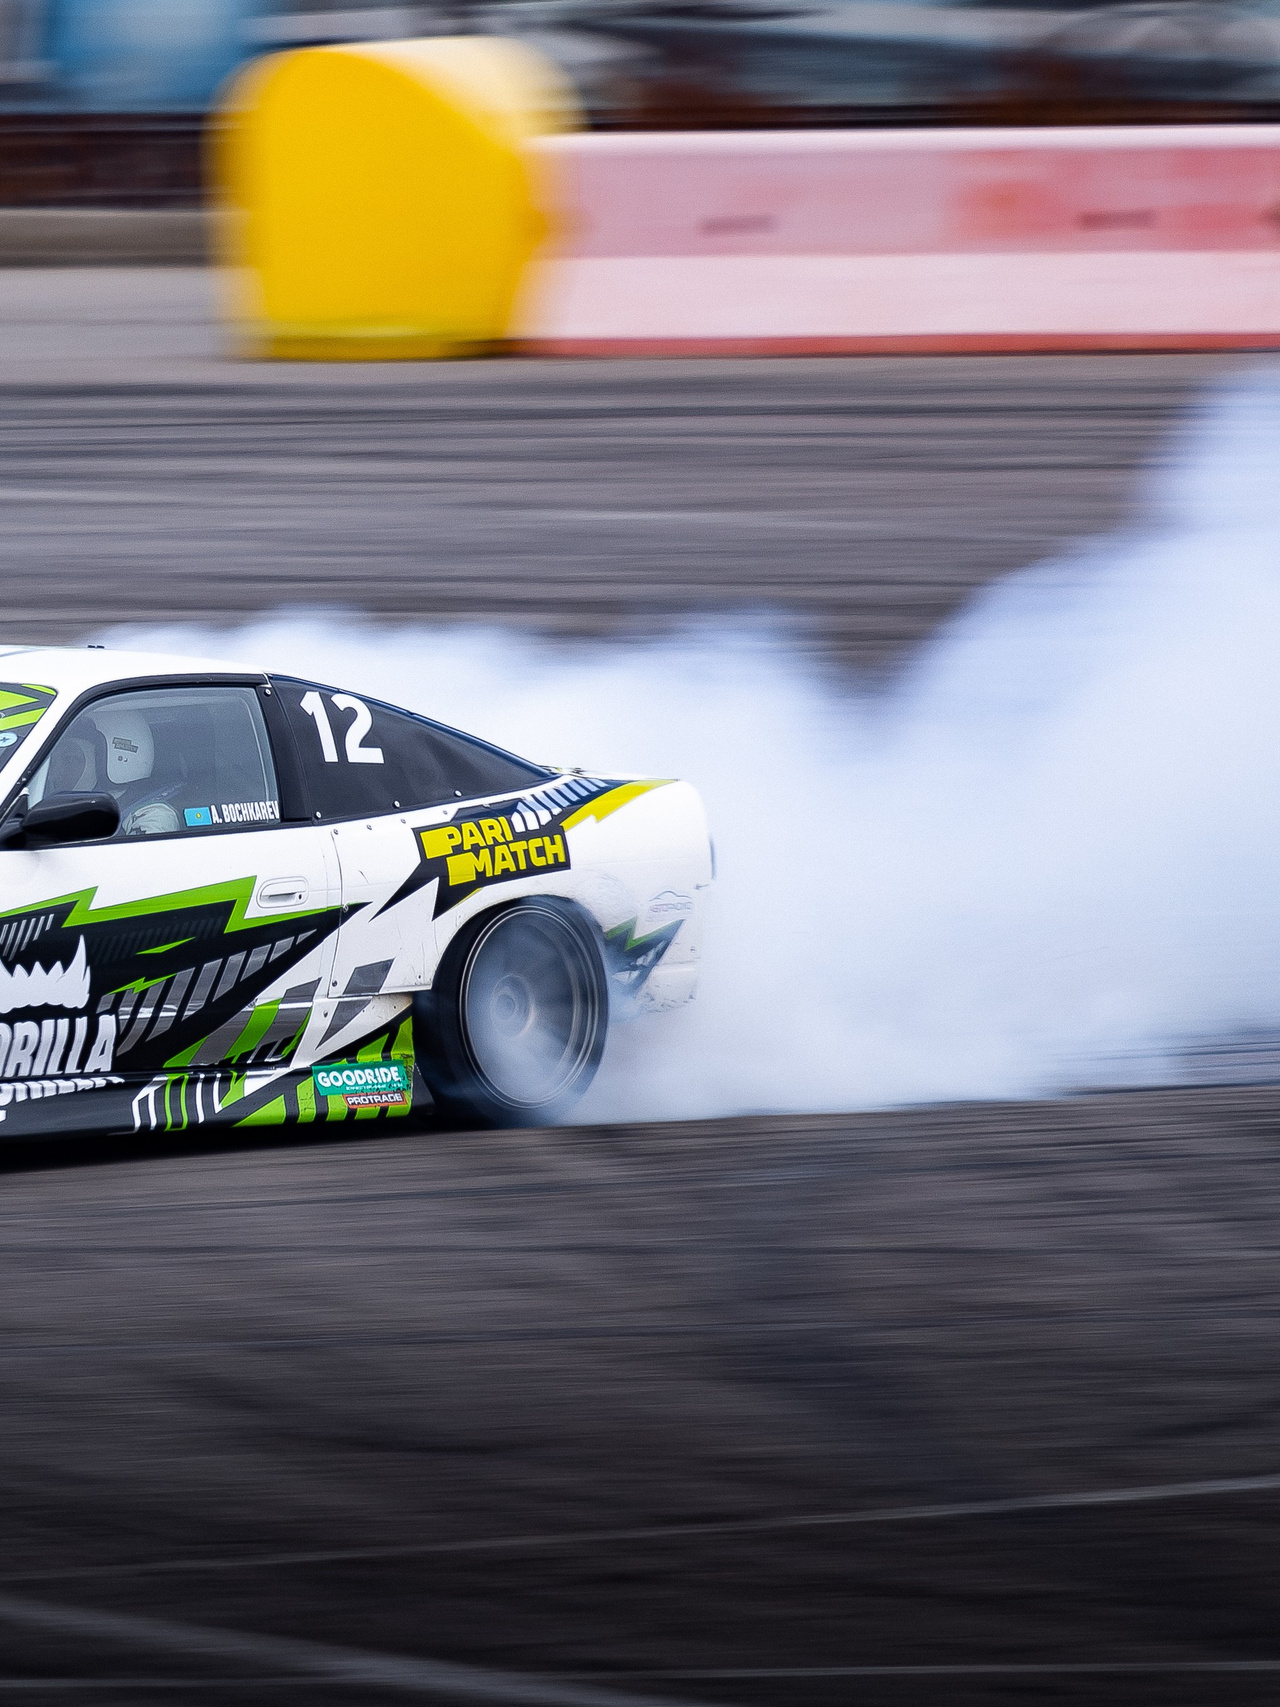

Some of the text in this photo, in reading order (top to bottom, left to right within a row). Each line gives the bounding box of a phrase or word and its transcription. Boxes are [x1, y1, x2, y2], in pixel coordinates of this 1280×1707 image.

[300, 691, 384, 763] 12
[211, 801, 280, 823] A. BOCHKAREV
[420, 816, 513, 859] PARI
[446, 834, 566, 886] MATCH
[317, 1066, 402, 1088] GOODRIDE
[346, 1093, 403, 1105] PROTRADE
